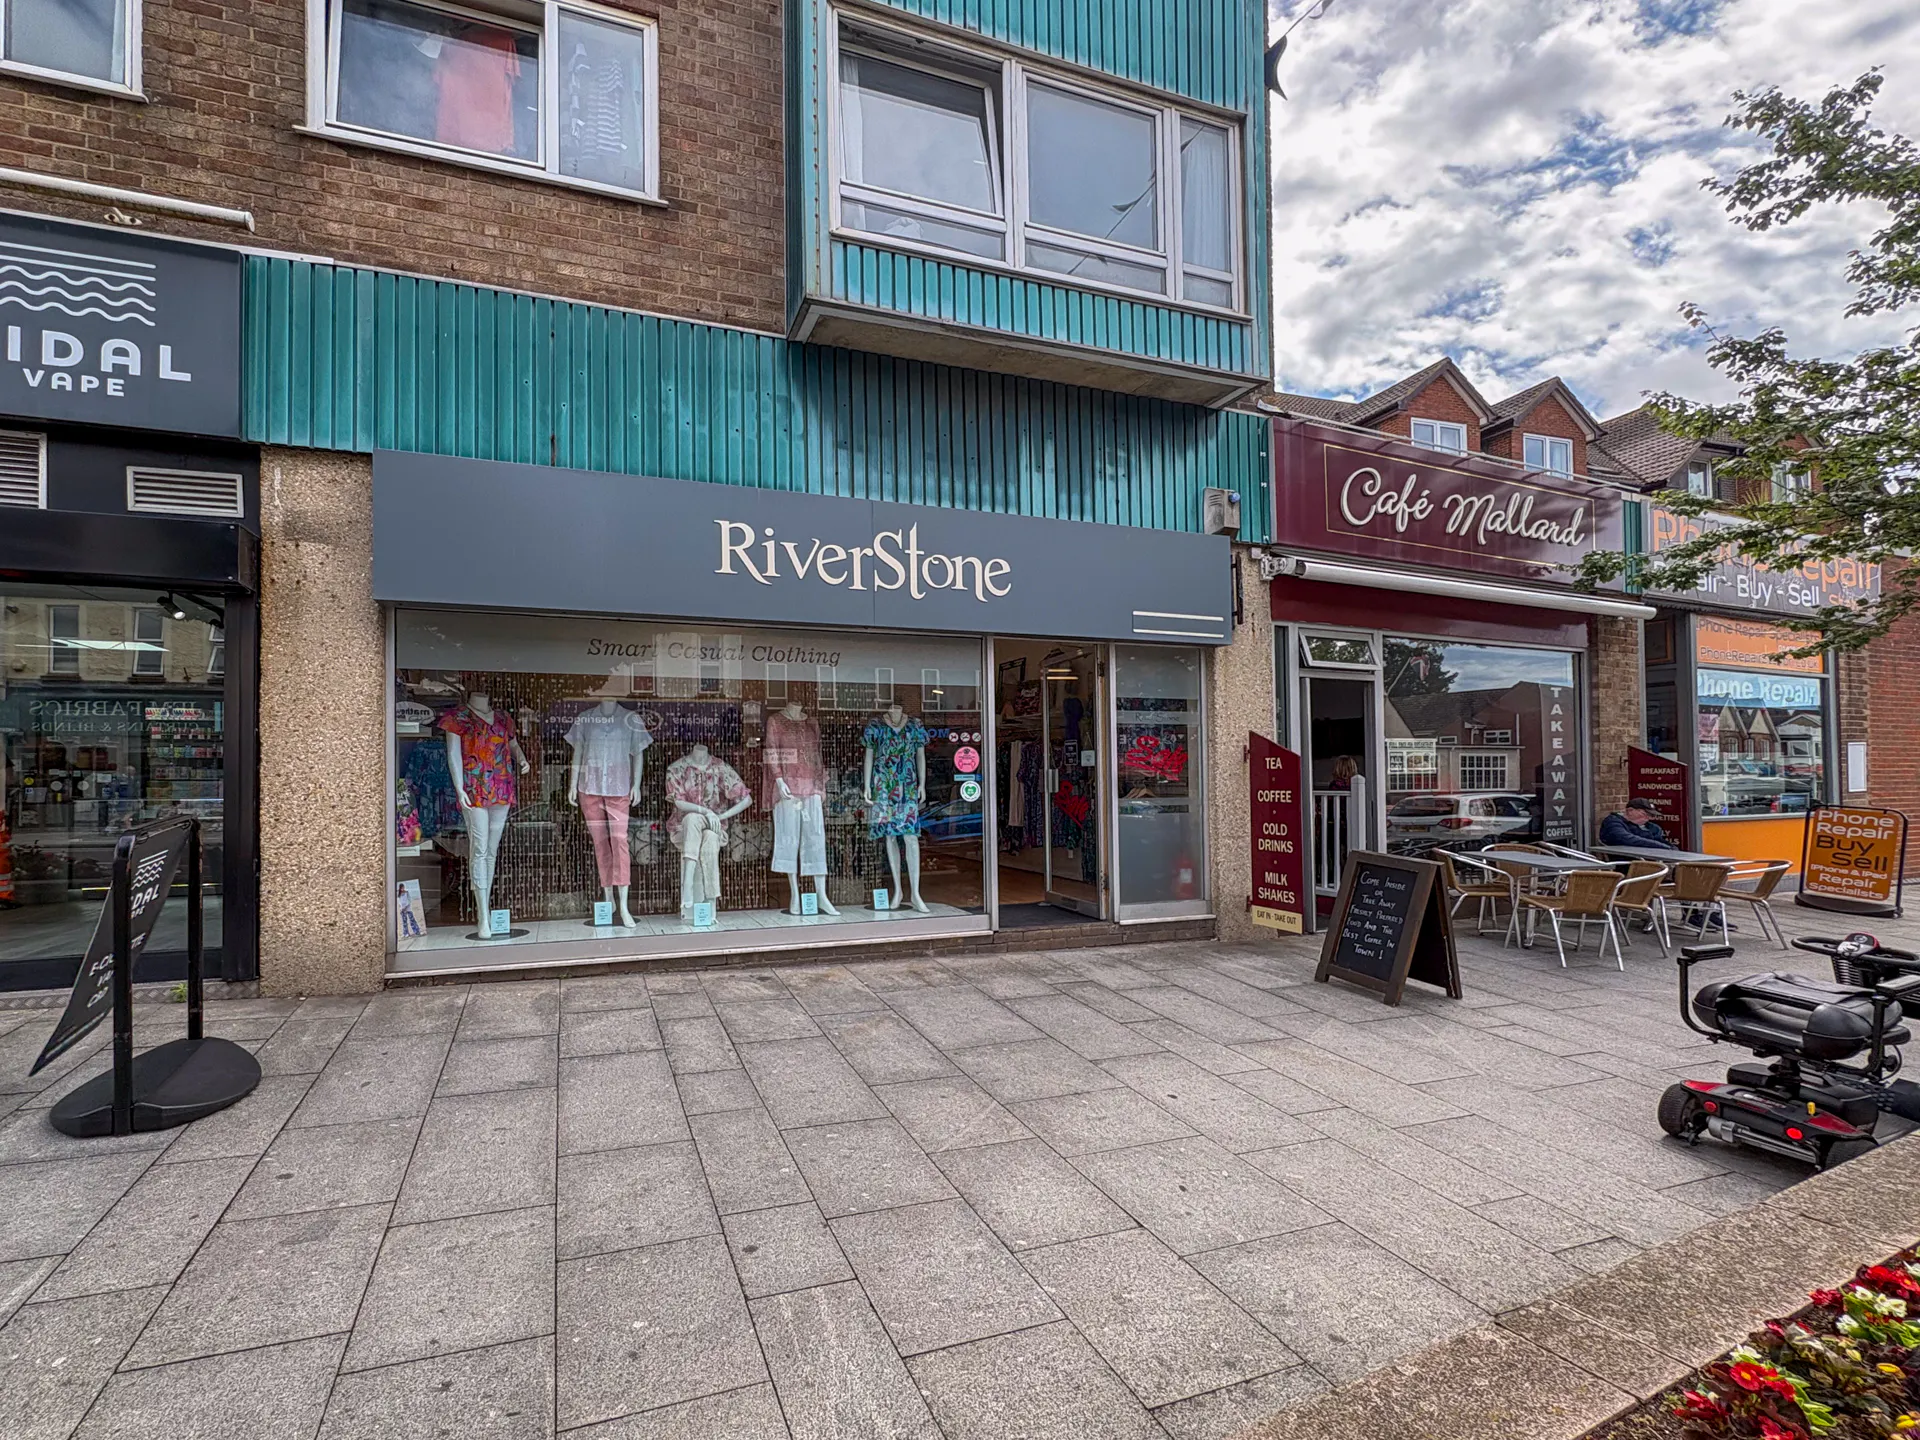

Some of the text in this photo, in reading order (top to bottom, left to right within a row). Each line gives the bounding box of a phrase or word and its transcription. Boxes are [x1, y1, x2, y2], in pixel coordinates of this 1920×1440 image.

[23, 368, 125, 397] VAPE
[1340, 467, 1586, 547] Café Mallard
[714, 519, 1012, 603] RiverStone
[1737, 574, 1773, 607] Buy
[1788, 583, 1820, 608] Sell
[587, 638, 841, 668] Smart Casual Clothing
[1758, 678, 1817, 705] Repair
[1126, 735, 1188, 776] Sale
[1550, 687, 1566, 817] TAKEAWAY
[1265, 757, 1283, 770] TEA
[1640, 767, 1680, 775] BREAKFAST
[1637, 783, 1683, 791] SANDWICHES
[1257, 789, 1292, 804] COFFEE
[1818, 810, 1895, 827] Phone
[1263, 822, 1288, 837] COLD
[1546, 827, 1573, 837] COFFEE
[1816, 822, 1894, 840] Repair
[1258, 838, 1294, 854] DRINKS
[1816, 834, 1875, 856] Buy
[1831, 852, 1888, 872] Sell
[1264, 871, 1288, 887] MILK
[1819, 873, 1877, 889] Repair
[1258, 886, 1296, 904] SHAKES
[1808, 882, 1884, 899] Specialists
[1256, 909, 1297, 926] EAT IN TAKE OUT
